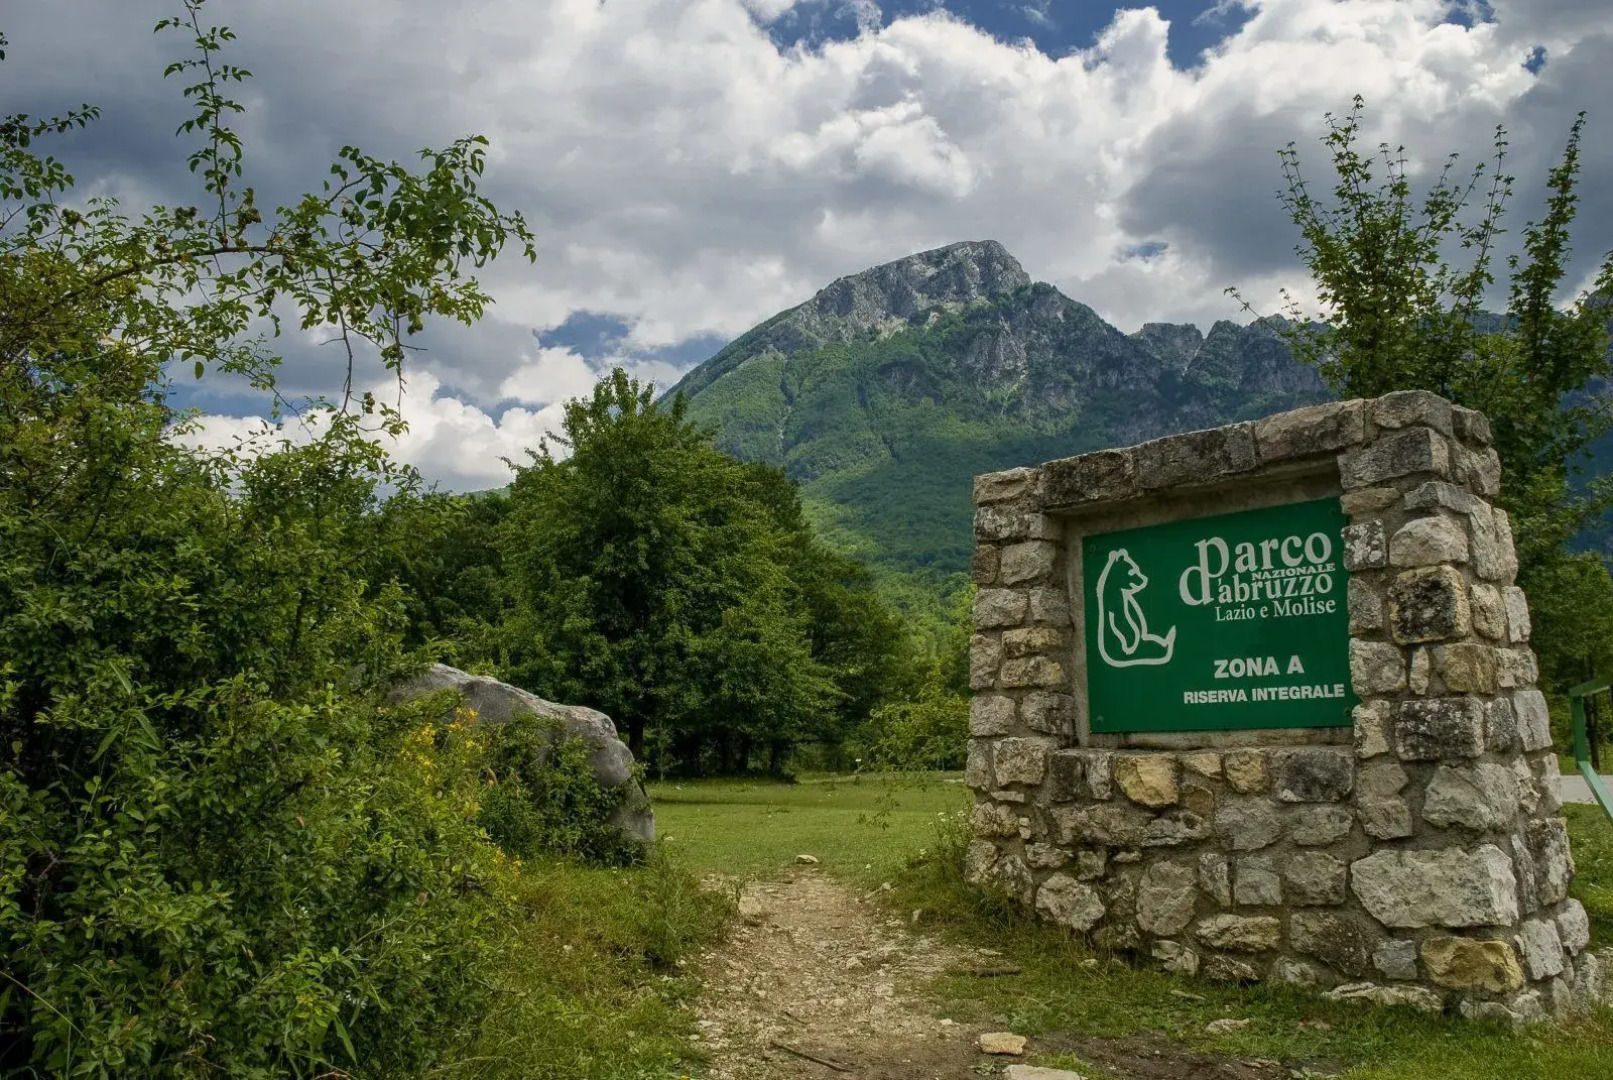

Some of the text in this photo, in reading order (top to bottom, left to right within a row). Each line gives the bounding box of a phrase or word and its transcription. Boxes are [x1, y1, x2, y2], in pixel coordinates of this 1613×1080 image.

[1252, 563, 1336, 581] NAZIONALE
[1215, 596, 1337, 622] Lazio e Molise
[1214, 655, 1305, 679] ZONA A
[1183, 684, 1345, 704] RISERVA INTEGRALE
